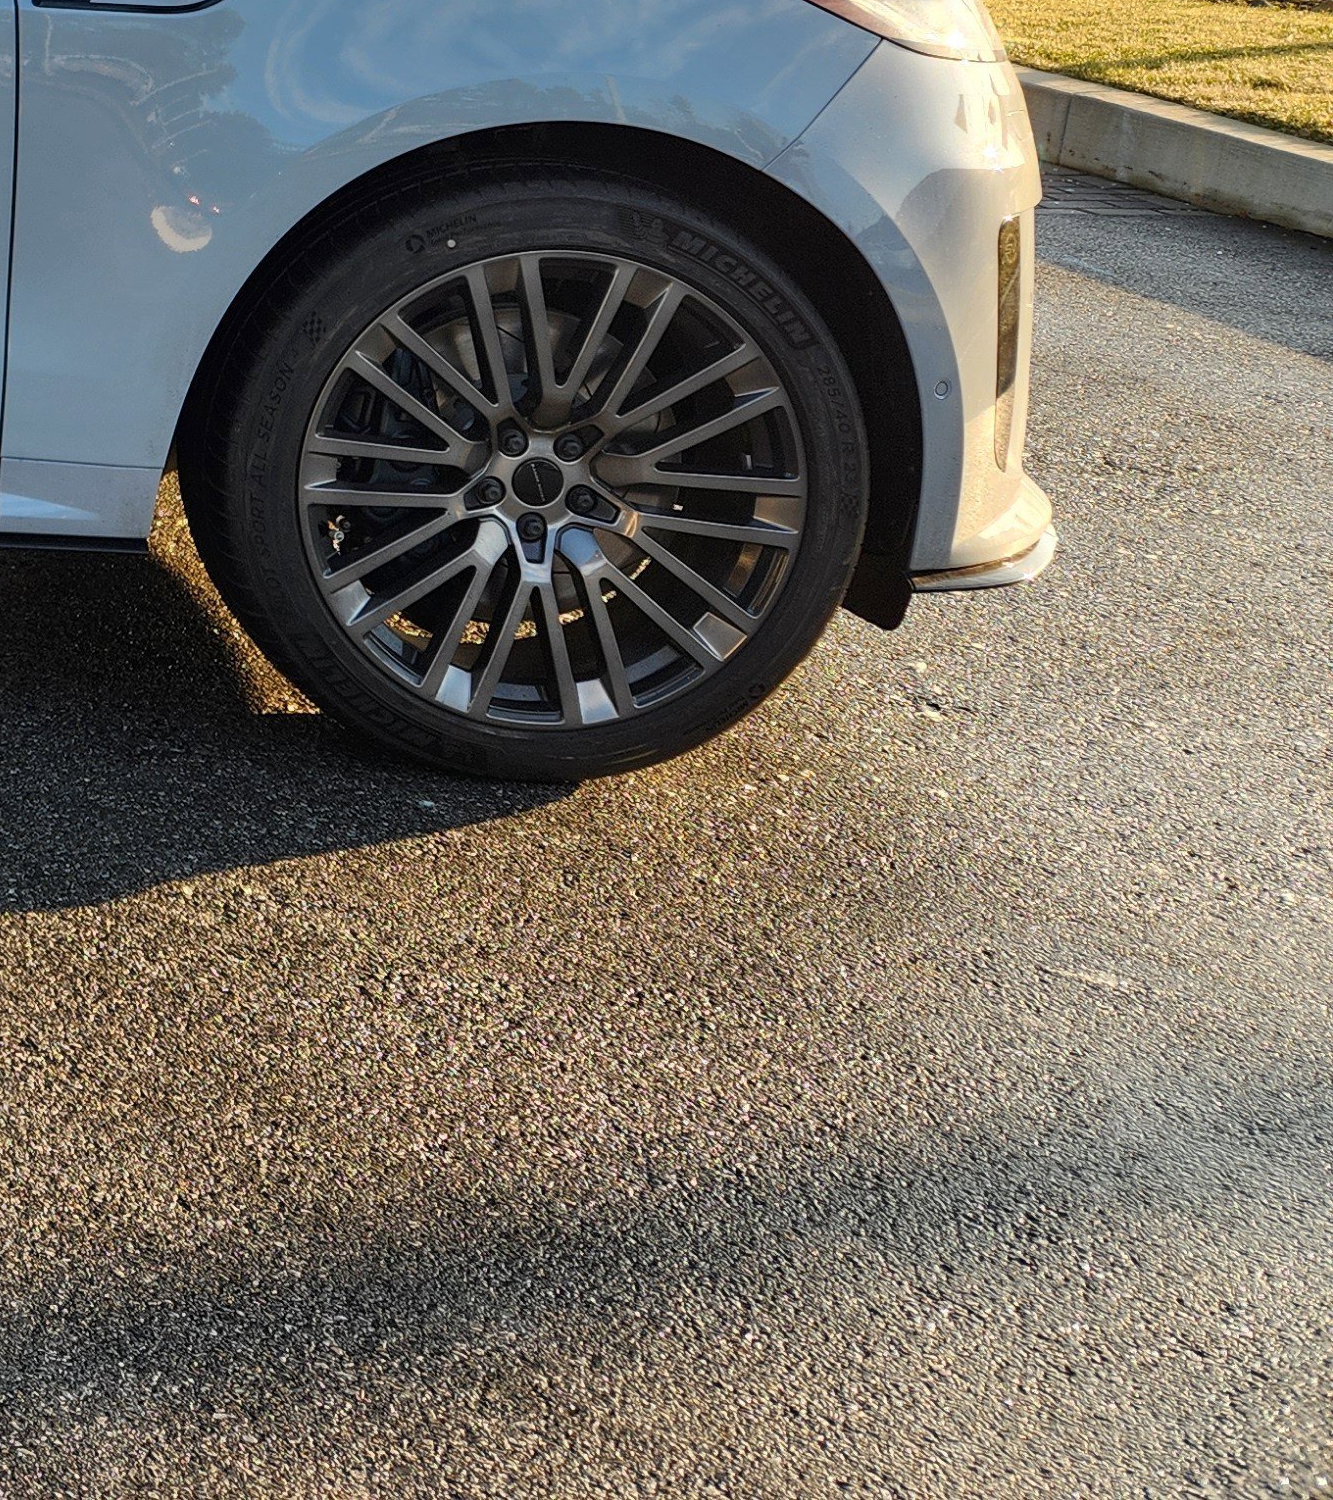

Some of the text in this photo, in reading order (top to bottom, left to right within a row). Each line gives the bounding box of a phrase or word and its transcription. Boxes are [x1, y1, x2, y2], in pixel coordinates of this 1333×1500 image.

[425, 213, 477, 238] MICHELIN
[671, 230, 813, 344] MICHELIN
[256, 361, 295, 442] SEASON
[816, 364, 851, 434] 285/40
[250, 450, 268, 487] ALL
[250, 493, 272, 560] SPORT
